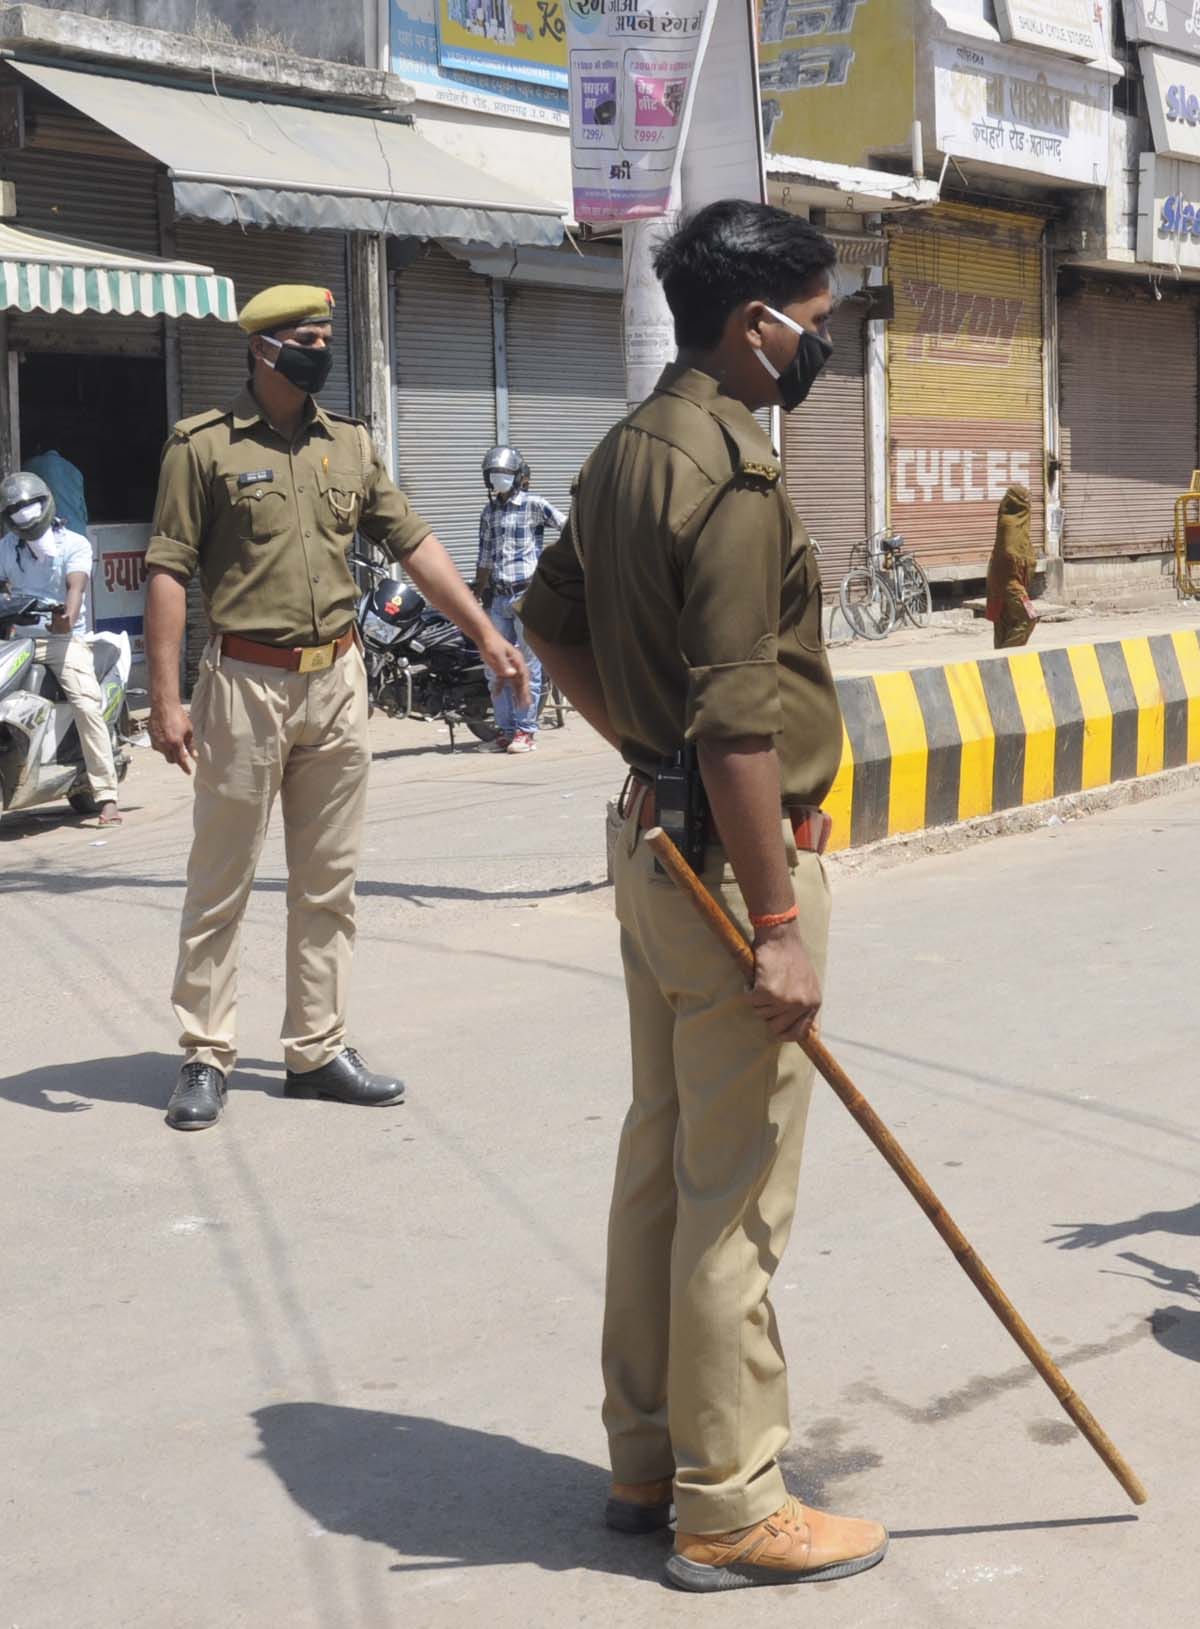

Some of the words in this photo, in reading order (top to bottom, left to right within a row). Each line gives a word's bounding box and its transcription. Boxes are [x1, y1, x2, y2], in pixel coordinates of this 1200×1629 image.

[972, 117, 1004, 150] कचेहरी
[902, 279, 1025, 367] AVON
[896, 449, 1031, 502] CYCLES
